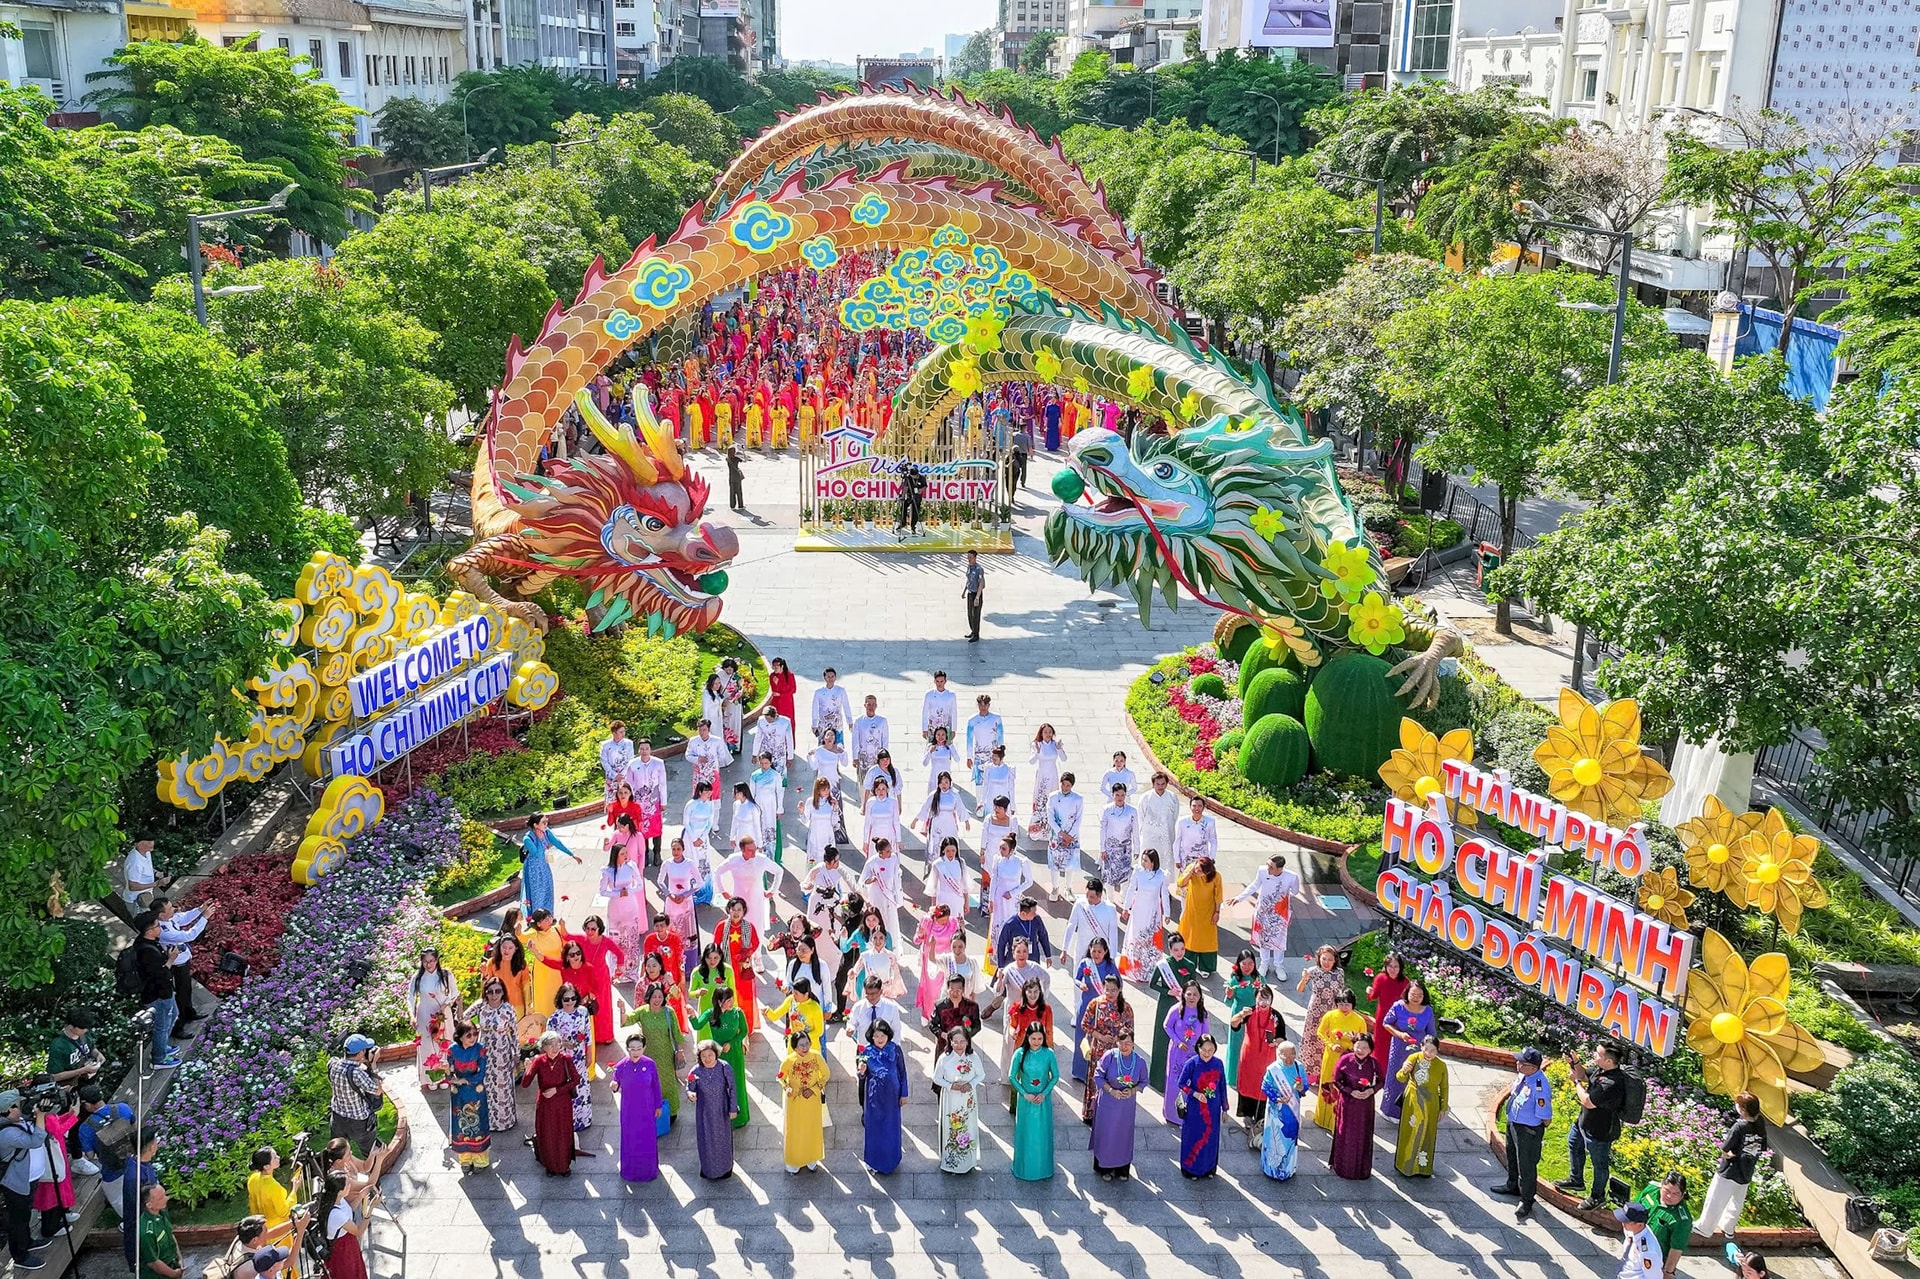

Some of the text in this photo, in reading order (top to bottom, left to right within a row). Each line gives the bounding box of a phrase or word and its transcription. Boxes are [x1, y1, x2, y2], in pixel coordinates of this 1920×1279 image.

[816, 480, 847, 498] HO
[852, 480, 887, 498] CHI
[945, 480, 996, 499] CITY
[341, 654, 512, 776] HO CHI MINH CITY
[357, 615, 490, 717] WELCOME TO
[1442, 759, 1562, 844] THÀNH
[1376, 869, 1673, 1058] CHÀO ĐÓN BẠN
[1456, 840, 1544, 922] CHÍ
[1543, 877, 1688, 995] MINH
